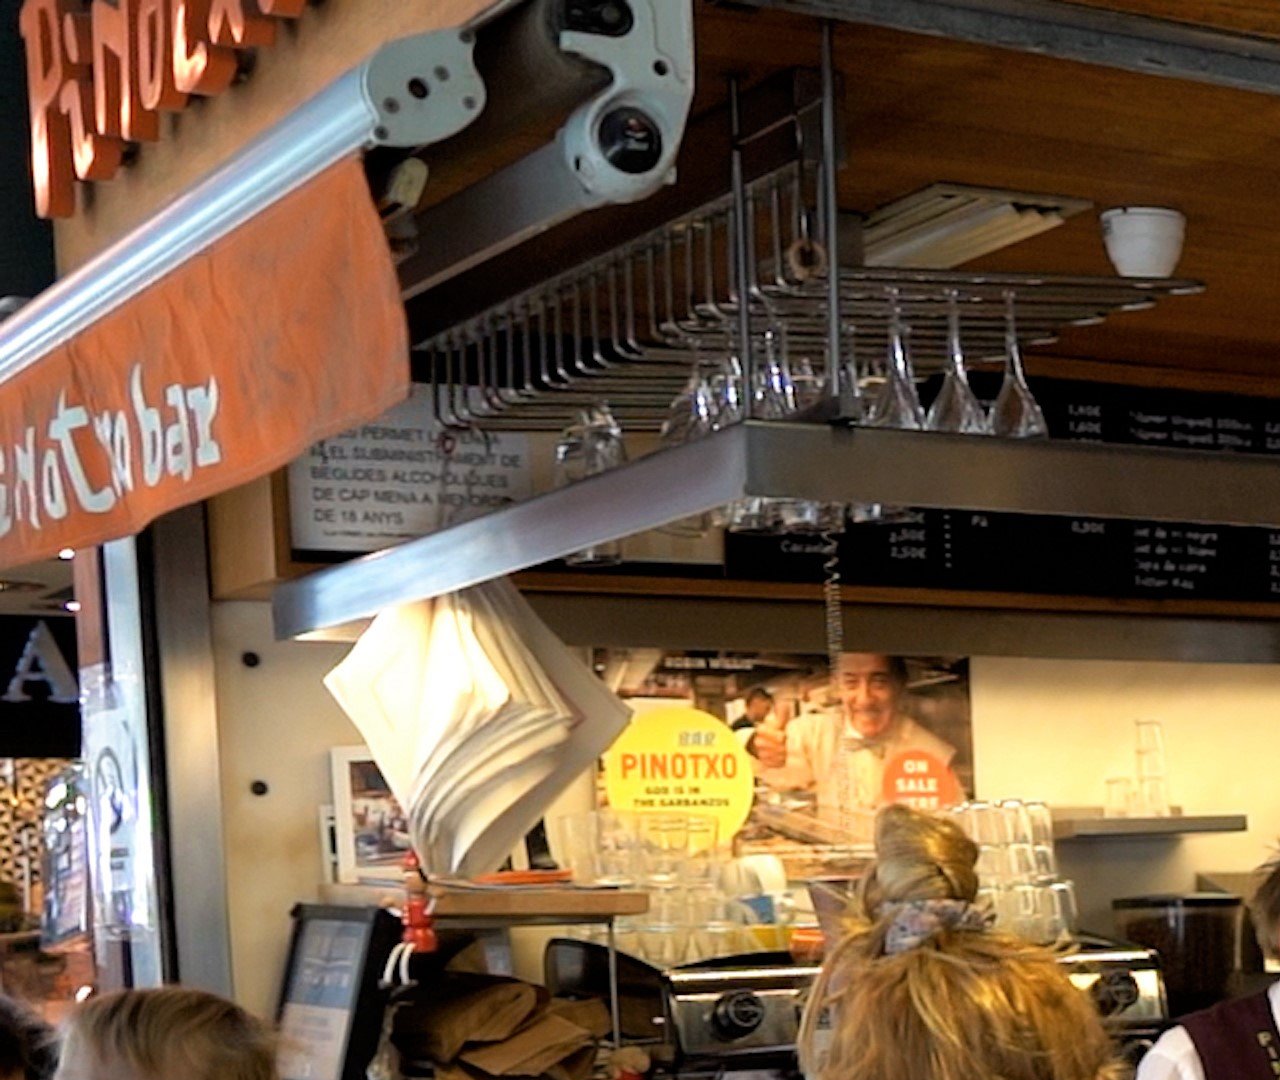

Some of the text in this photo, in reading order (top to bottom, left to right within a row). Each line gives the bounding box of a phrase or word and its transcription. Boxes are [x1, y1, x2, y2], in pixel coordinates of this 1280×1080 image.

[130, 363, 221, 487] bar
[313, 487, 335, 502] DE
[339, 488, 370, 502] CAP
[314, 508, 336, 523] DE
[362, 510, 405, 526] ANYS
[621, 753, 738, 779] PINOTXO
[903, 760, 929, 774] ON
[895, 777, 938, 793] SALE
[633, 799, 655, 807] THE
